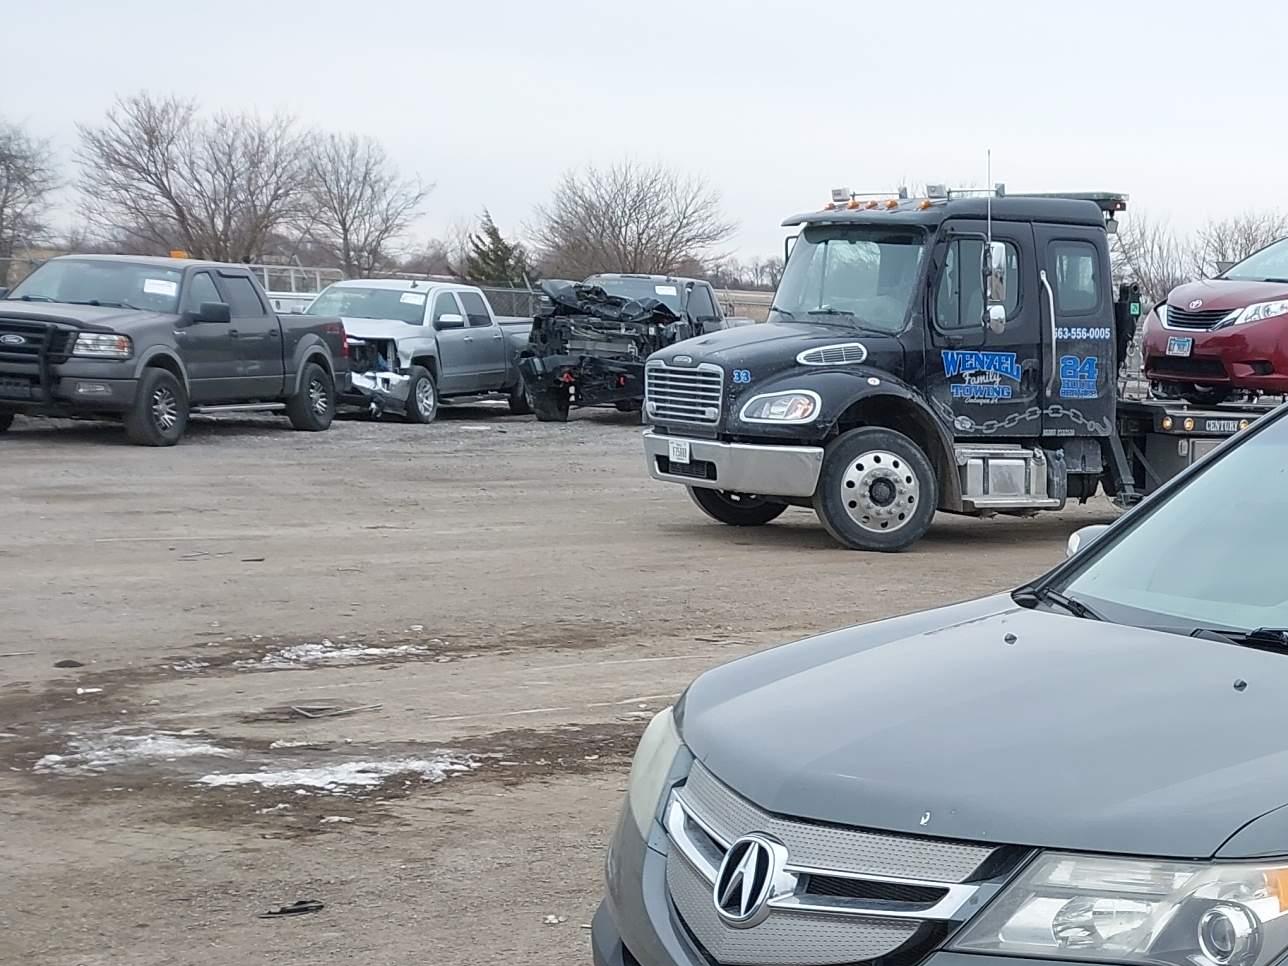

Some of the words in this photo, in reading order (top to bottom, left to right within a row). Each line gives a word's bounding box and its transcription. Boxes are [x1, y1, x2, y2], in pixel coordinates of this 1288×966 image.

[941, 350, 1022, 383] WENZEL
[1060, 355, 1098, 380] 24
[733, 369, 751, 383] 33
[962, 370, 1001, 388] Family
[951, 384, 1012, 398] TOWING
[1206, 420, 1239, 431] CENTURY
